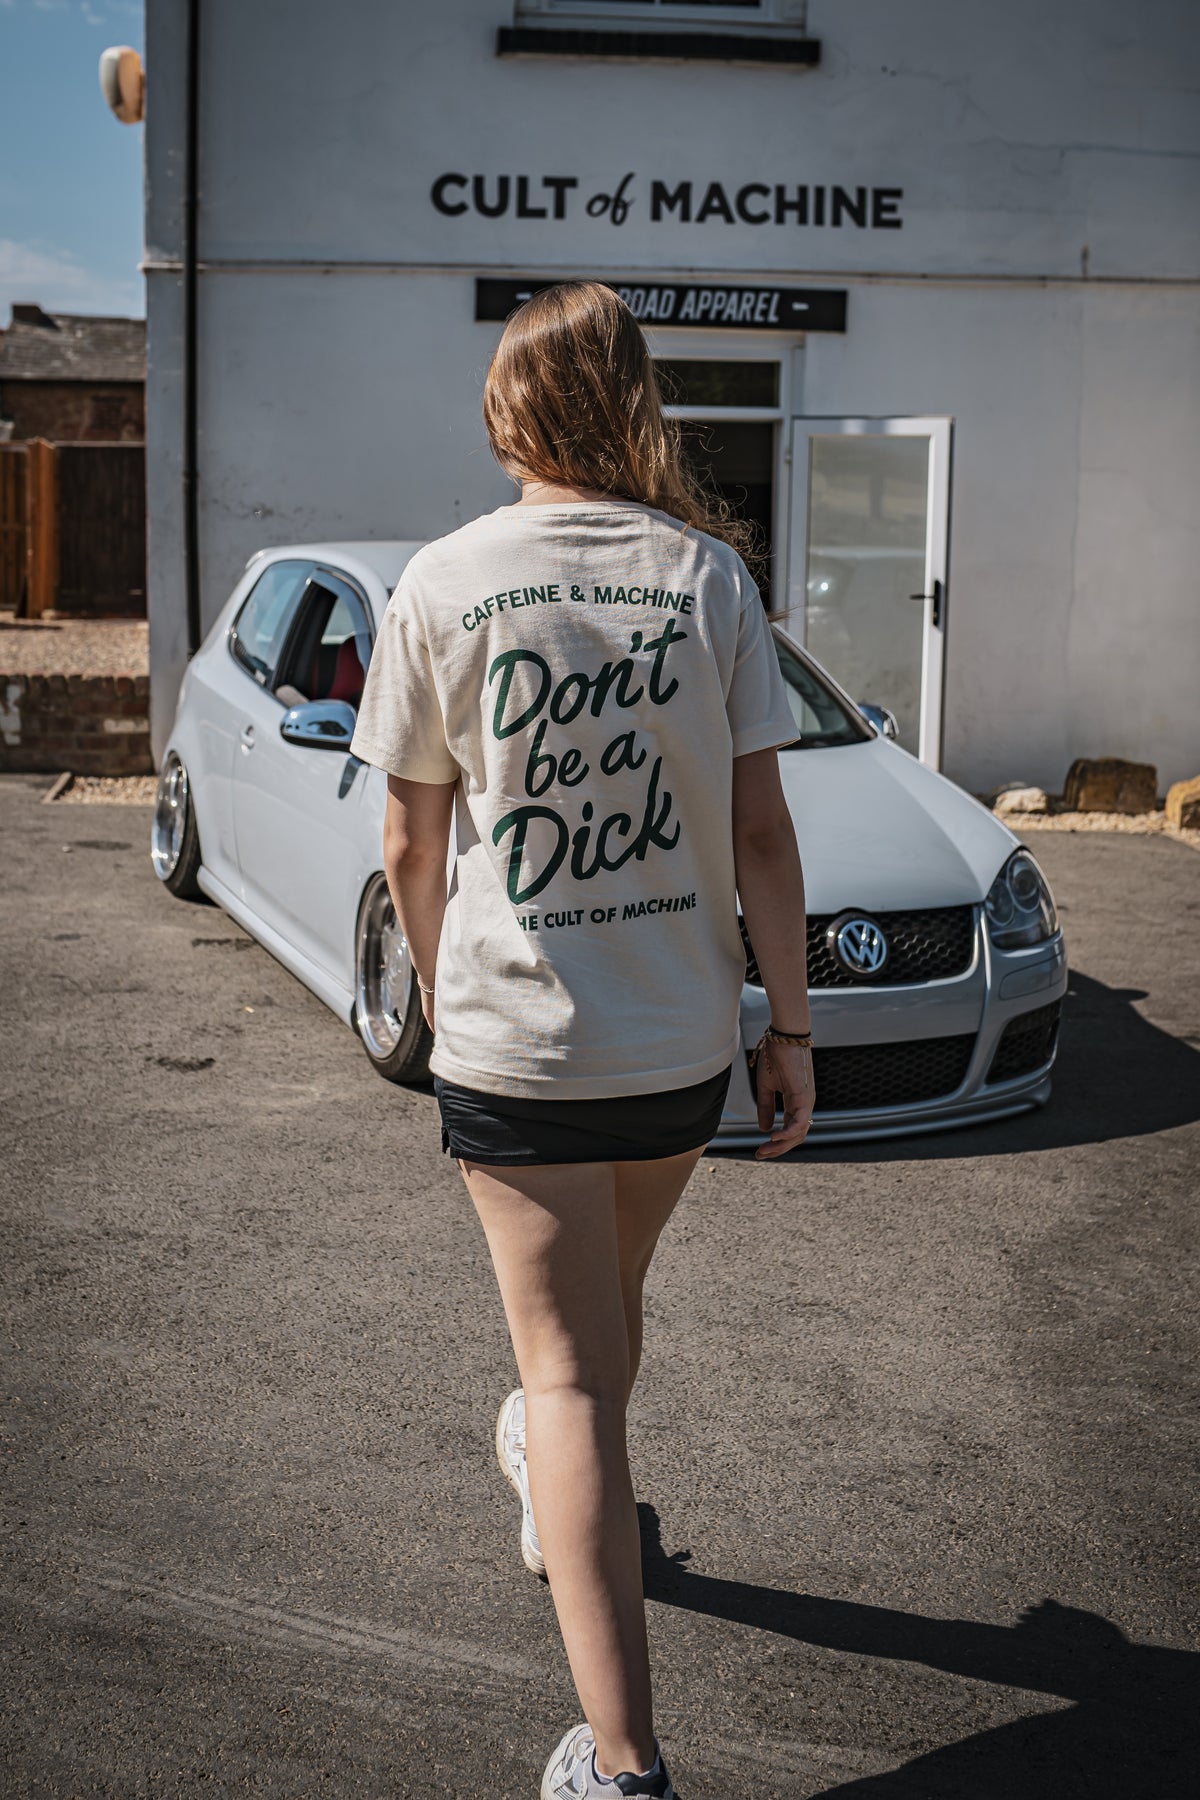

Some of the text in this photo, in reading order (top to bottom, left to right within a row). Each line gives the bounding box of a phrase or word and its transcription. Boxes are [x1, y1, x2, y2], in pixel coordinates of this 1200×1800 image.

[430, 172, 904, 230] CULT of MACHINE
[679, 291, 780, 324] APPAREL
[462, 584, 695, 632] CAFFEINE & MACHINE
[488, 618, 688, 741] Don't
[524, 718, 647, 798] be a
[492, 755, 681, 906] Dick
[517, 892, 697, 931] HE CULT OF MACHINE
[837, 919, 888, 974] VW
